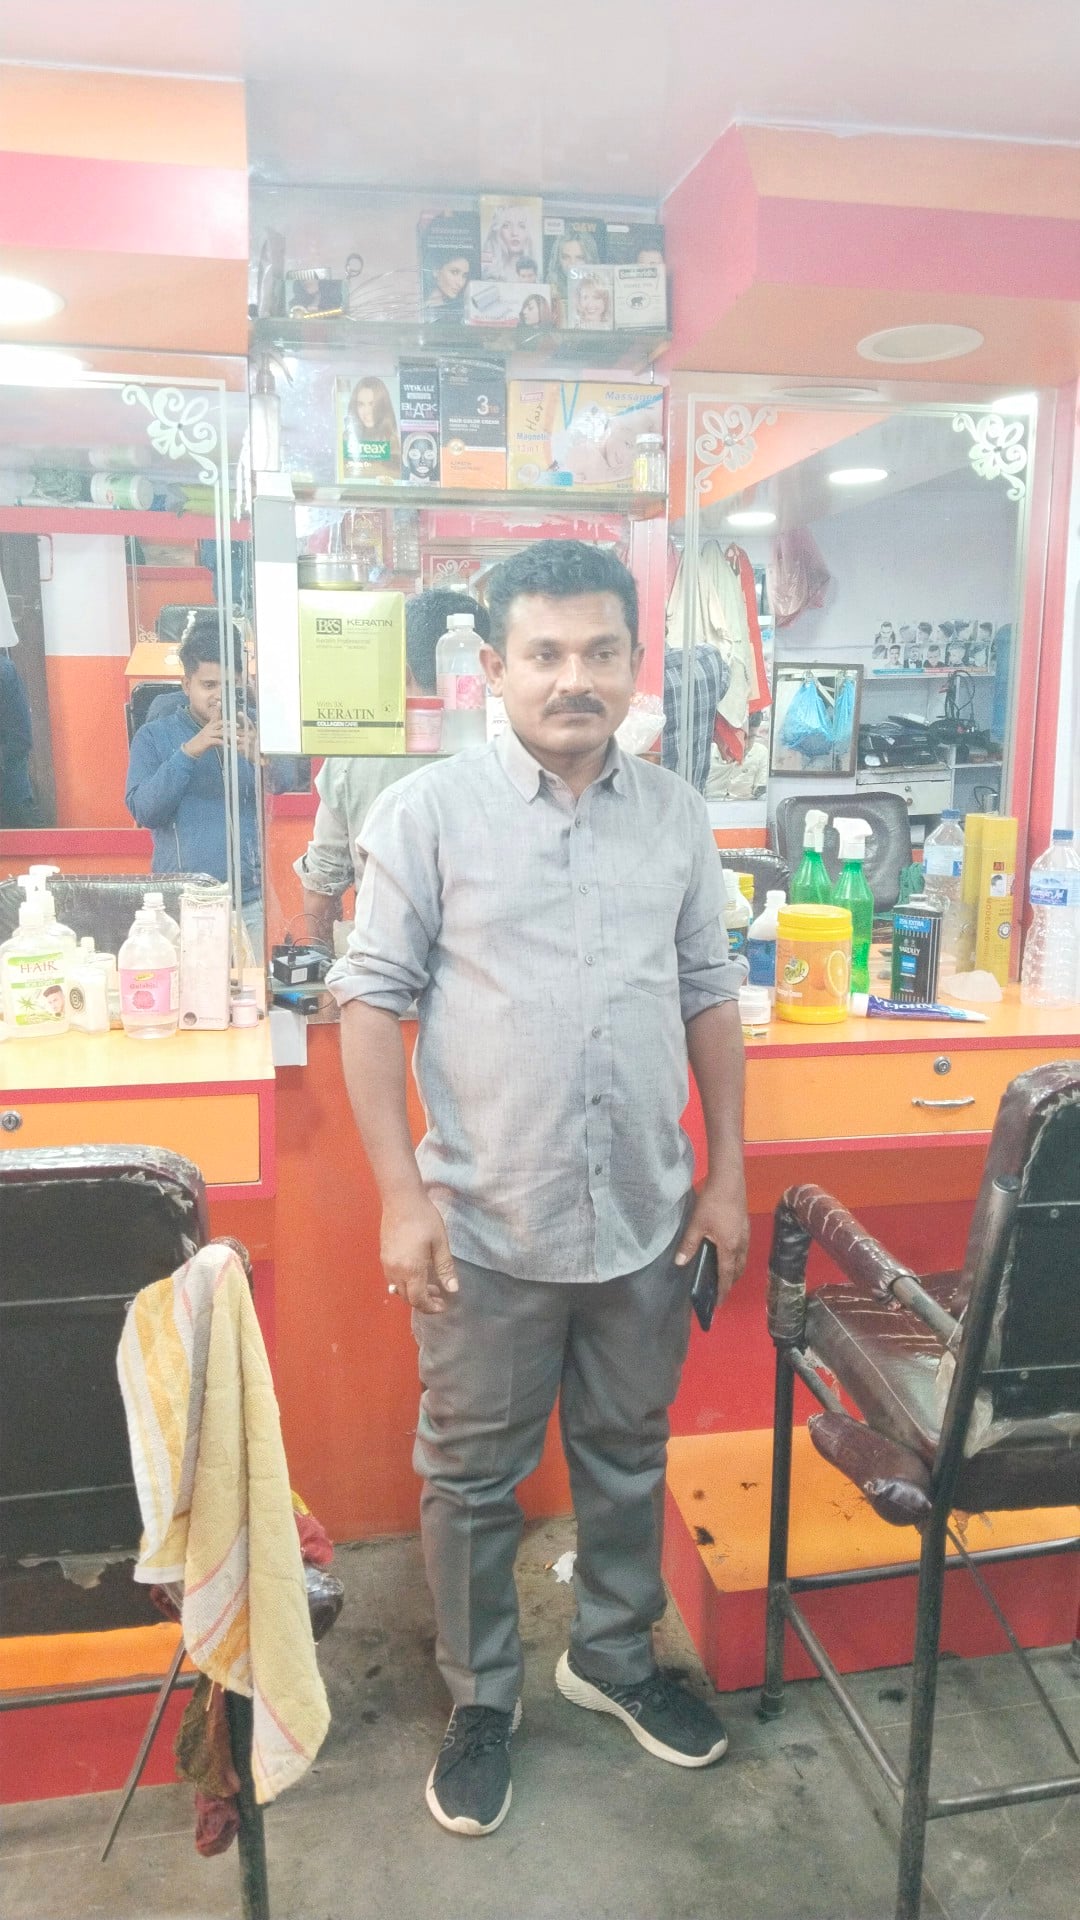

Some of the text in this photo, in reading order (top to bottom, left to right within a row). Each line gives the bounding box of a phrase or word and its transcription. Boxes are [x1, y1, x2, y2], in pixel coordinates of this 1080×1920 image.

[401, 402, 438, 415] BLACK
[346, 618, 393, 627] KERATIN
[317, 708, 375, 720] KERATIN
